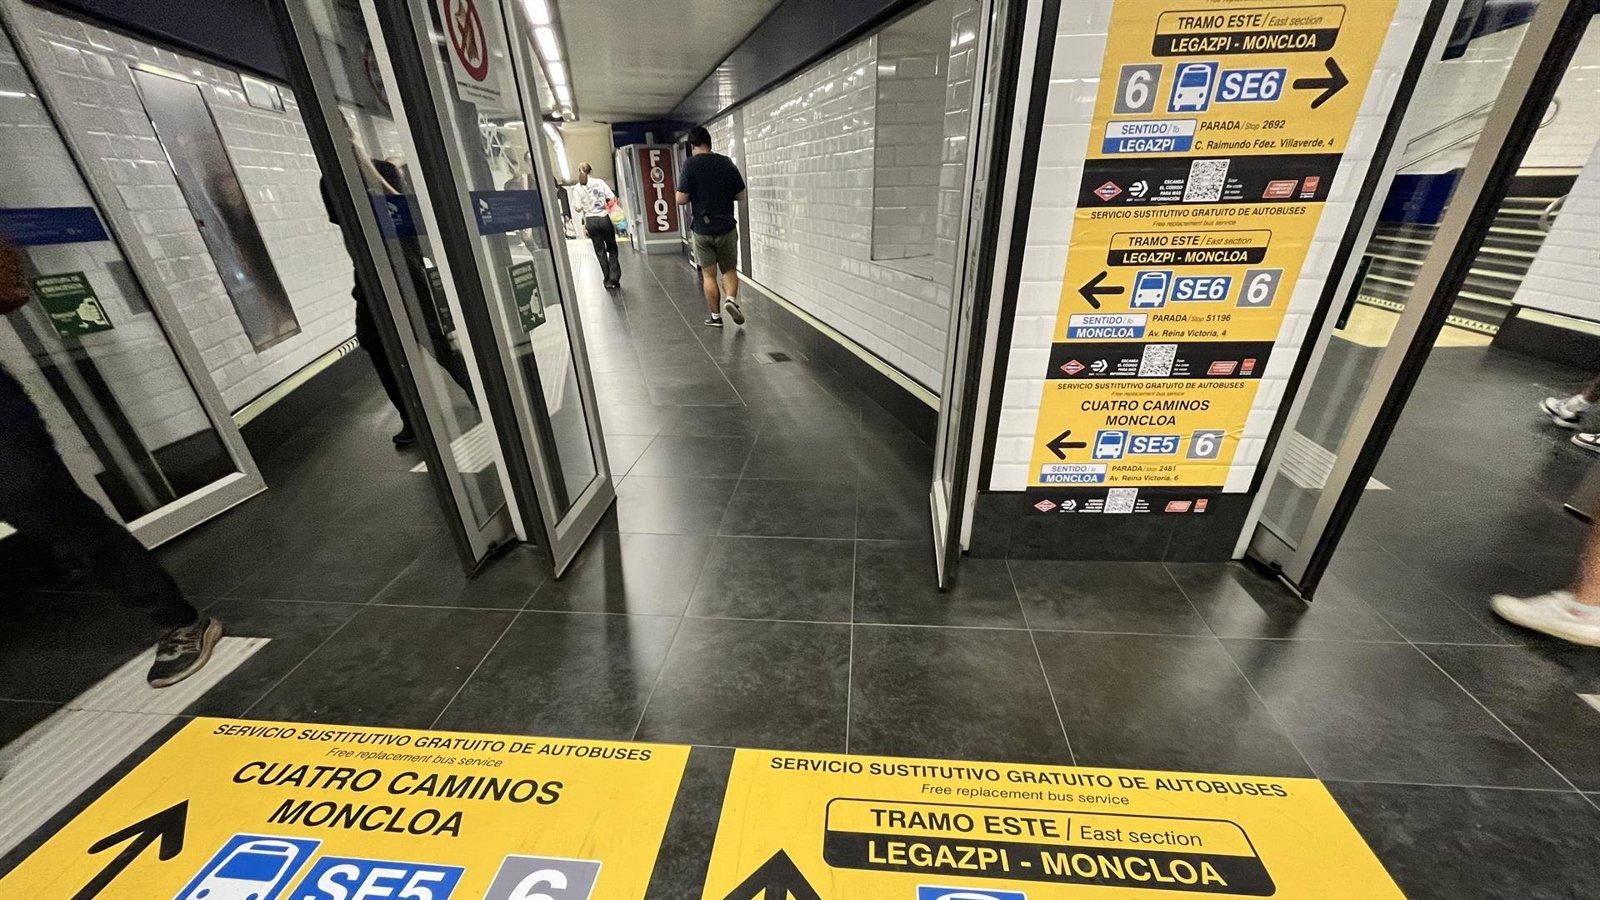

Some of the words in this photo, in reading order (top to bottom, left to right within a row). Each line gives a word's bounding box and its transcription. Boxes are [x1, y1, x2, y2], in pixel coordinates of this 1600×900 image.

[1178, 16, 1224, 29] TRAMO
[1227, 14, 1262, 28] ESTE
[1268, 17, 1288, 27] East
[1290, 16, 1322, 26] section
[1171, 36, 1231, 52] LEGAZPI
[1242, 34, 1317, 50] MONCLOA
[1125, 69, 1151, 109] 6
[1222, 71, 1279, 100] SE6
[1121, 123, 1168, 135] SENTIDO
[1200, 121, 1240, 131] PARADA
[1262, 119, 1286, 129] 2692
[1119, 138, 1175, 153] LEGAZPI
[1194, 140, 1204, 150] C.
[1206, 140, 1251, 150] Raimundo
[1280, 138, 1325, 149] Villaverde,
[1327, 138, 1335, 147] 4
[649, 150, 670, 231] FOTOS
[1091, 210, 1131, 220] SERVICIO
[1134, 209, 1190, 219] SUSTITUTIVO
[1192, 208, 1235, 217] GRATUITO
[1237, 207, 1250, 216] DE
[1252, 206, 1306, 216] AUTOBUSES
[1128, 236, 1168, 246] TRAMO
[1171, 235, 1200, 246] ESTE
[1206, 237, 1223, 245] East
[1225, 236, 1252, 244] section
[1122, 252, 1175, 264] LEGAZPI
[1184, 250, 1248, 262] MONCLOA
[1176, 278, 1226, 299] SE6
[1247, 273, 1272, 303] 6
[1082, 316, 1123, 325] SENTIDO
[1152, 314, 1187, 322] PARADA
[1206, 314, 1231, 322] 51196
[1076, 327, 1134, 338] MONCLOA
[1148, 329, 1159, 337] Av.
[1162, 329, 1185, 337] Reina
[1094, 382, 1143, 390] SUSTITUTIVO
[1197, 381, 1245, 389] AUTOBUSES
[1081, 400, 1139, 412] CUATRO
[1142, 399, 1210, 411] CAMINOS
[1105, 415, 1176, 426] MONCLOA
[1132, 436, 1176, 453] SE5
[1195, 433, 1215, 456] 6
[1051, 465, 1087, 473] SENTIDO
[1046, 474, 1099, 483] MONCLOA
[213, 724, 296, 739] SERVICIO
[297, 729, 411, 747] SUSTITUTIVO
[414, 736, 505, 752] GRATUITO
[508, 742, 536, 754] DE
[537, 744, 652, 761] AUTOBUSES
[326, 747, 355, 758] Free
[356, 750, 432, 764] replacement
[432, 753, 456, 765] bus
[458, 757, 503, 768] service
[232, 761, 383, 792] CUATRO
[387, 771, 563, 805] CAMINOS
[771, 757, 863, 774] SERVICIO
[870, 762, 1000, 782] SUSTITUTIVO
[1007, 770, 1112, 788] GRATUITO
[1118, 776, 1149, 790] DE
[1156, 778, 1288, 797] AUTOBUSES
[921, 783, 952, 795] Free
[956, 785, 1044, 801] replacement
[1048, 790, 1074, 802] bus
[1078, 793, 1130, 806] service
[267, 798, 464, 837] MONCLOA
[870, 808, 974, 833] TRAMO
[984, 815, 1060, 839] ESTE
[1080, 825, 1123, 843] East
[1129, 829, 1203, 847] section
[868, 840, 1010, 872] LEGAZPI
[1040, 851, 1228, 887] MONCLOA
